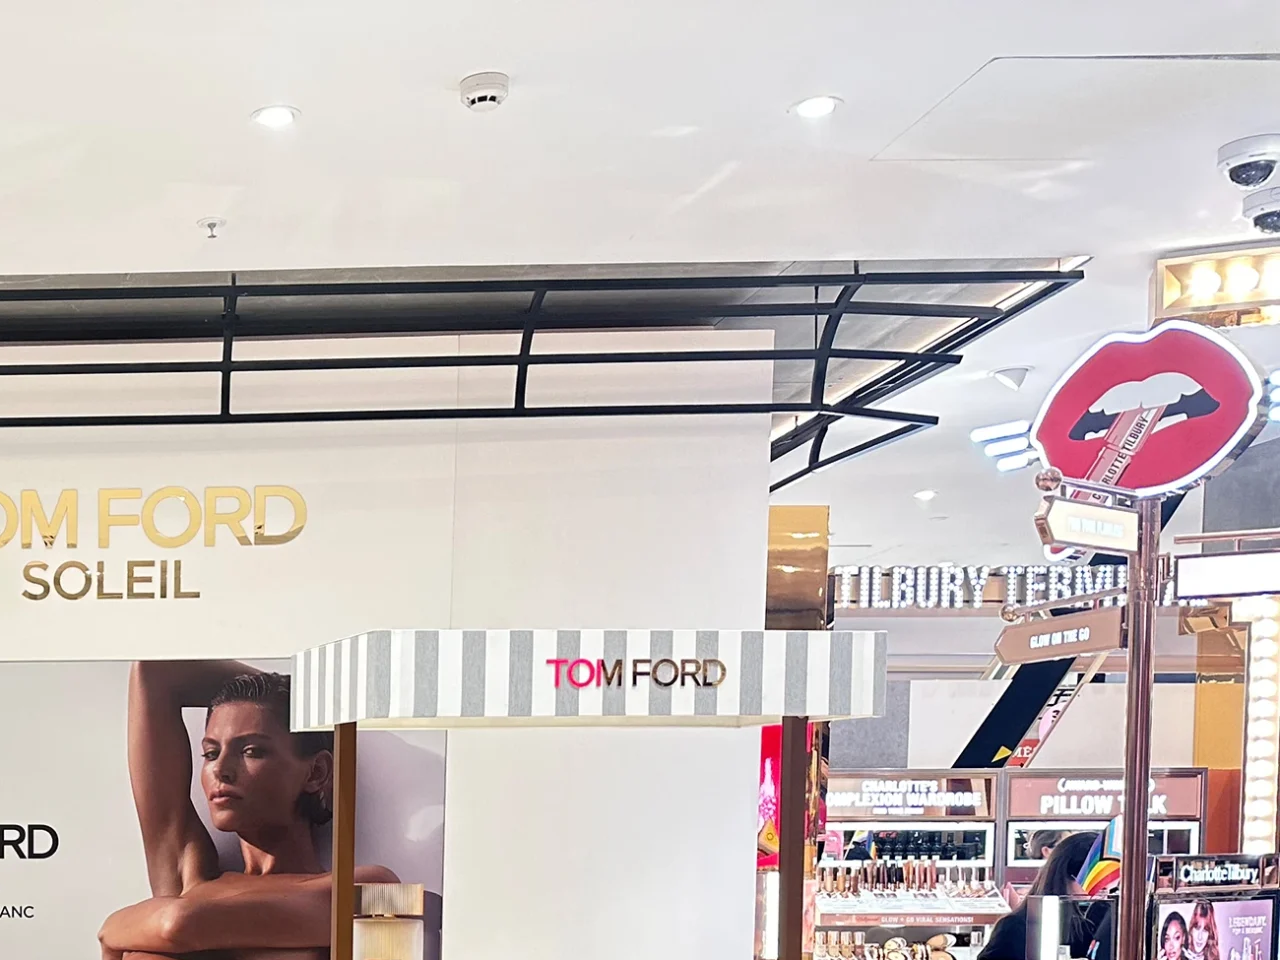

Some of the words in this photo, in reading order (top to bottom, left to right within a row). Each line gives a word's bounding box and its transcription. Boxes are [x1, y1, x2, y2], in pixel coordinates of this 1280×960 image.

[1121, 416, 1149, 452] TILBURY
[98, 485, 307, 549] FORD
[21, 559, 201, 601] SOLEIL
[833, 565, 991, 609] TILBURY
[546, 658, 623, 688] TOM
[632, 658, 727, 688] FORD
[825, 792, 903, 808] OMPLEXION
[1040, 795, 1114, 815] PILLOW
